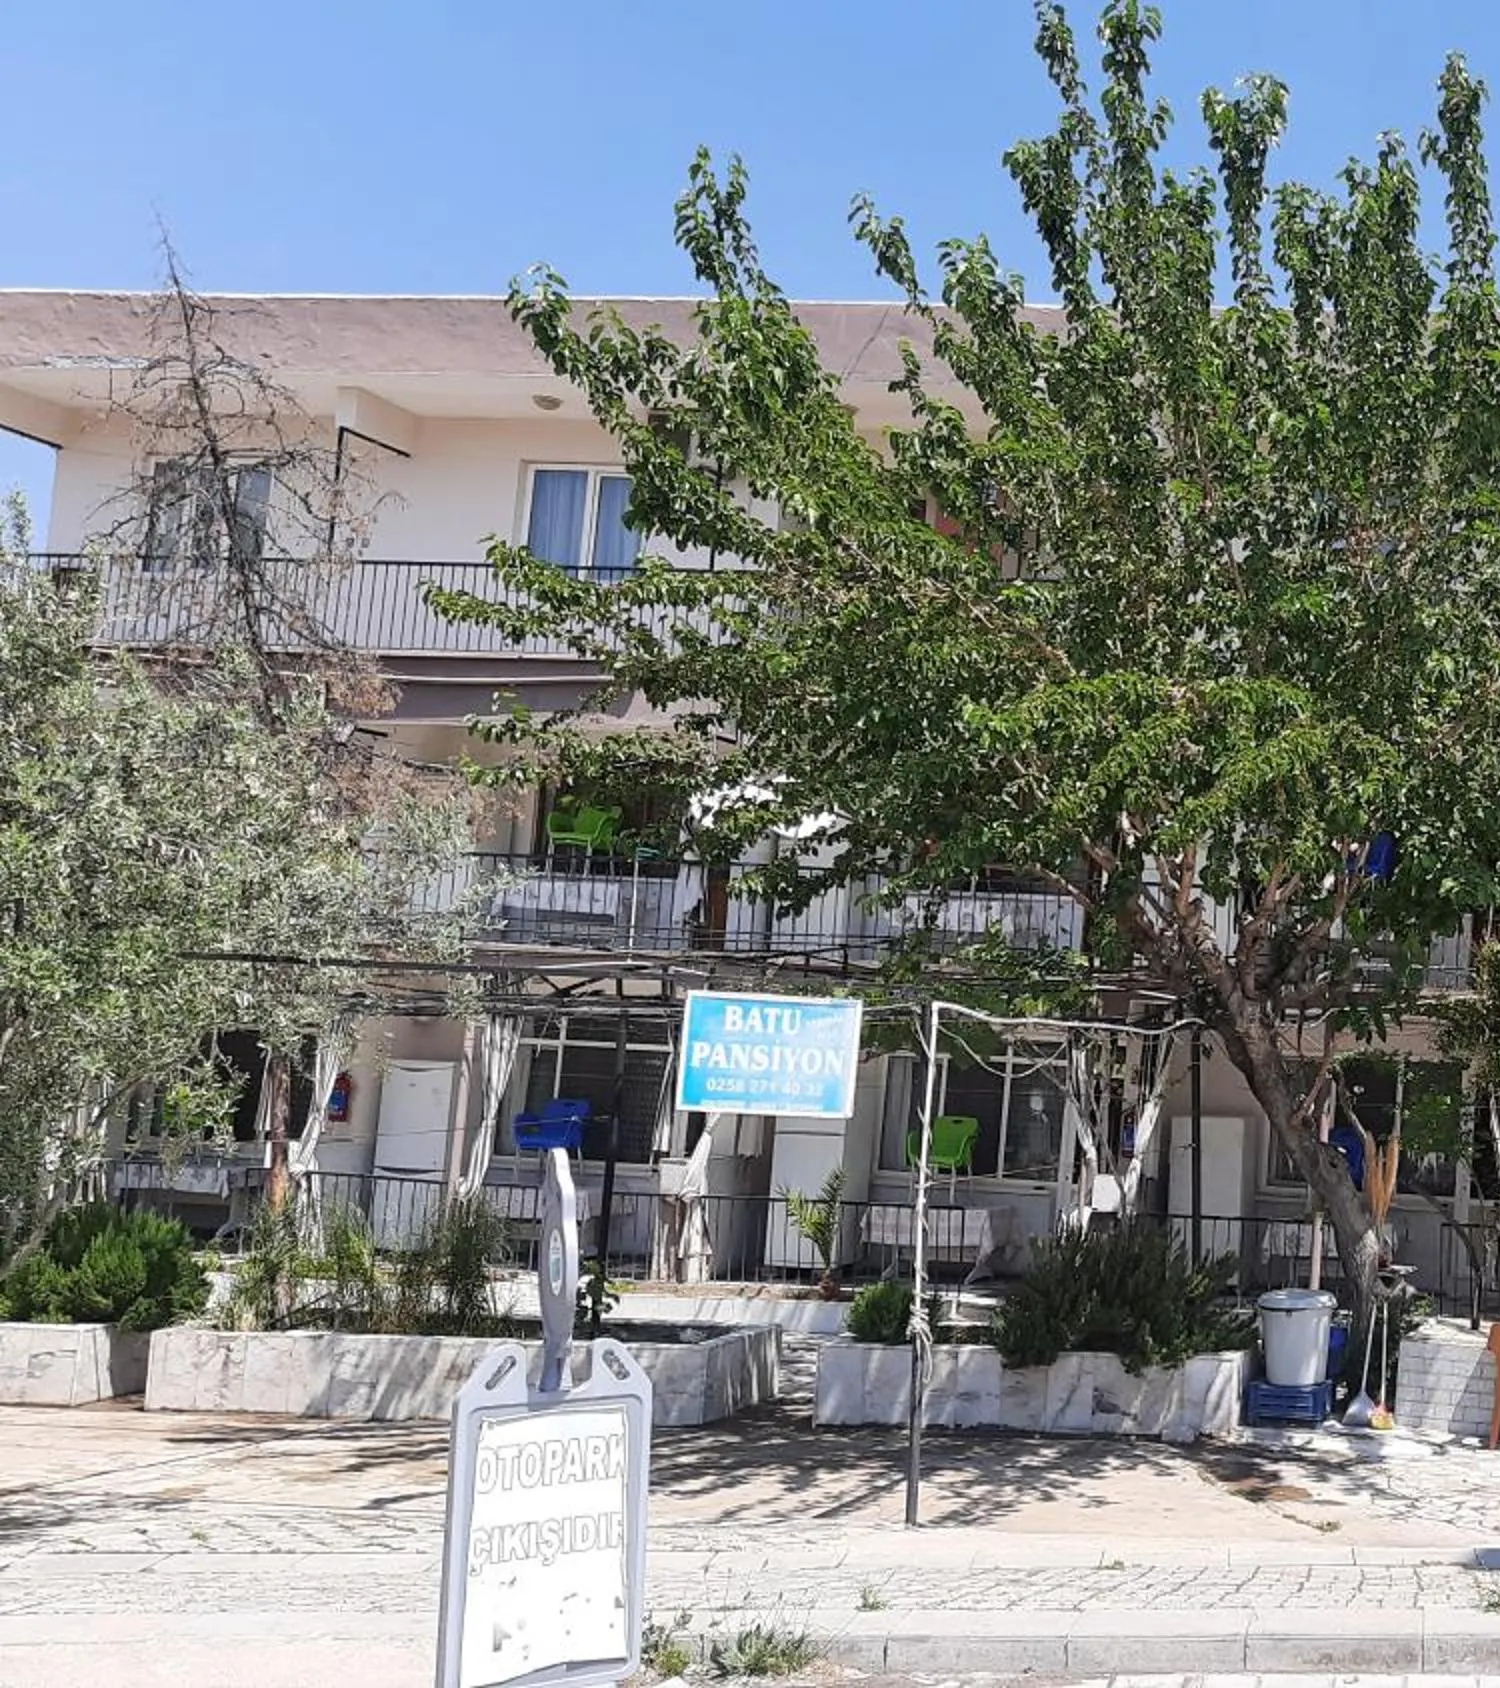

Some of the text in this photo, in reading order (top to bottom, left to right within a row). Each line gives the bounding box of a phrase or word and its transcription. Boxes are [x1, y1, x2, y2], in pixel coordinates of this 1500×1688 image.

[724, 1006, 801, 1034] BATU
[691, 1040, 844, 1075] PANSİYON
[475, 1434, 625, 1493] OTOPARK
